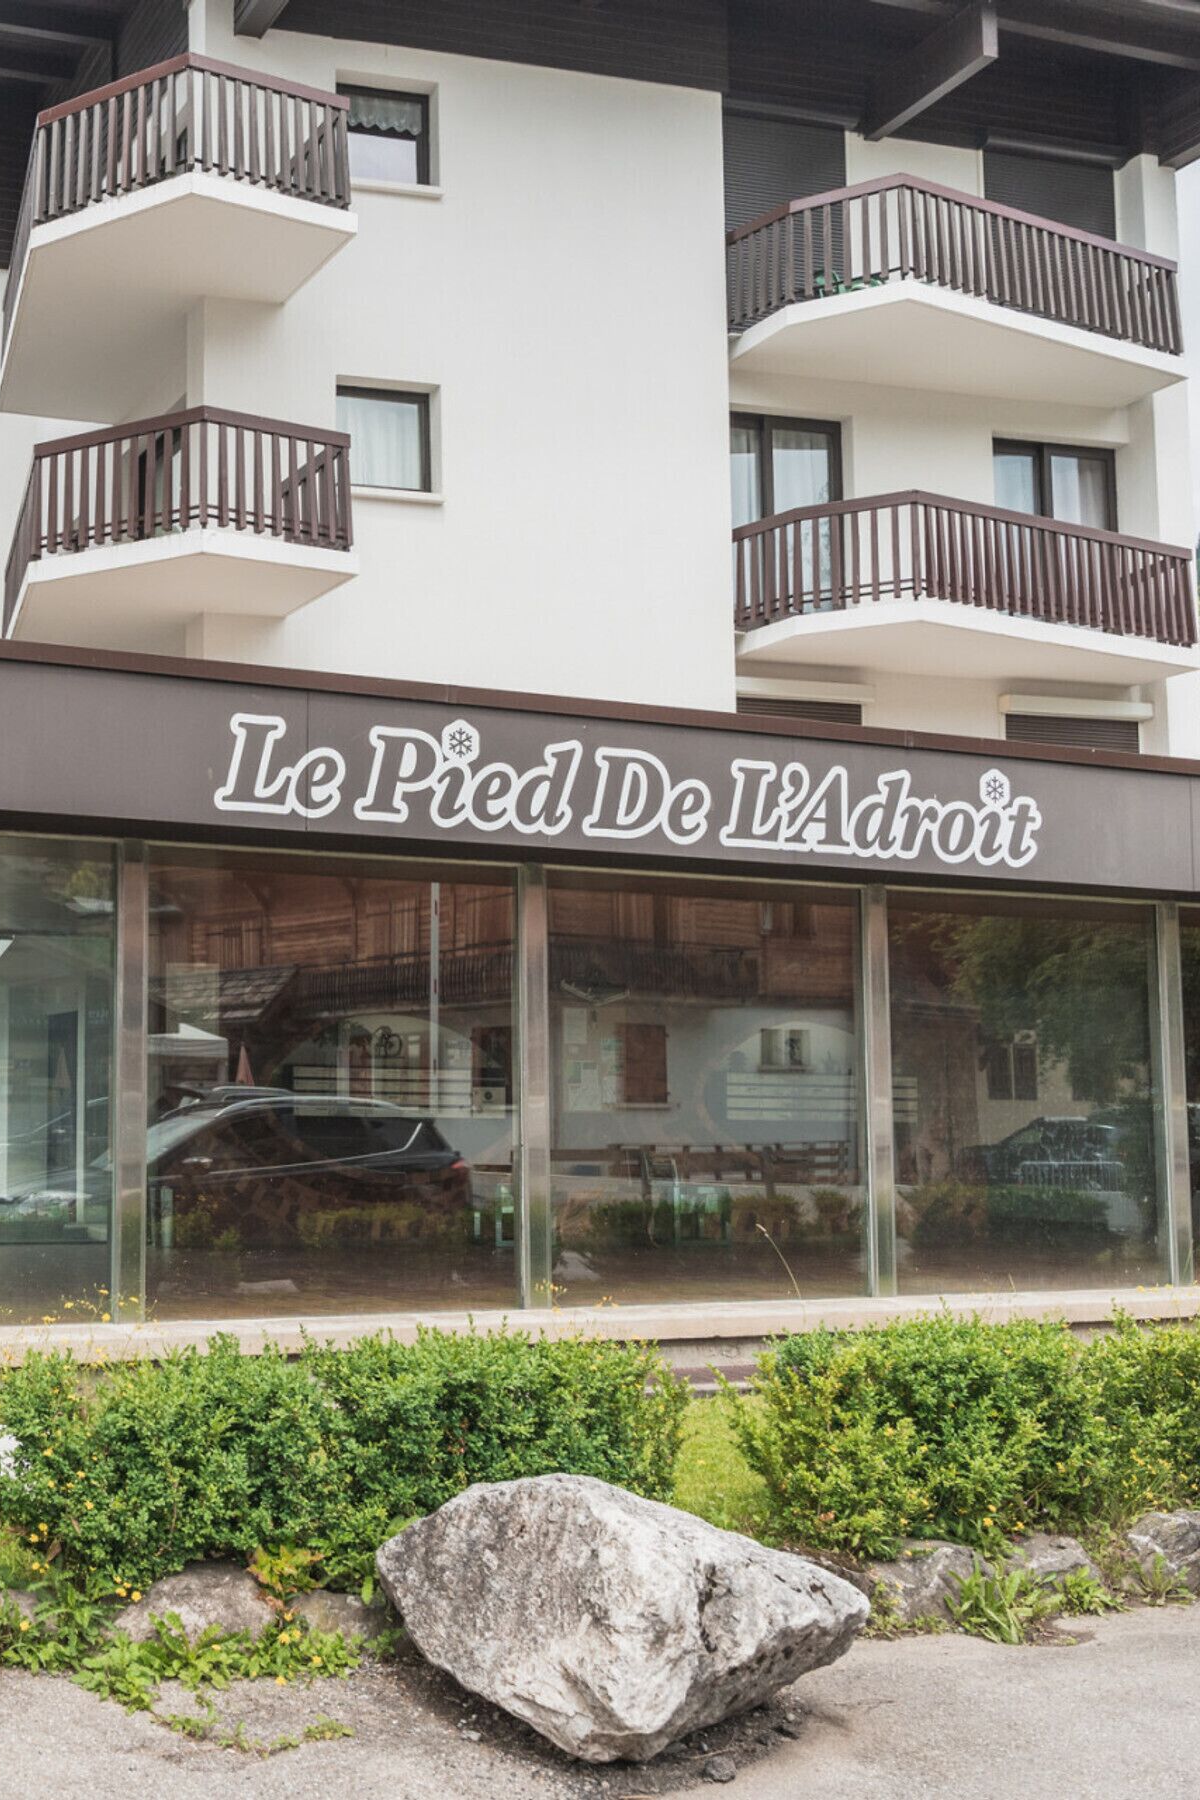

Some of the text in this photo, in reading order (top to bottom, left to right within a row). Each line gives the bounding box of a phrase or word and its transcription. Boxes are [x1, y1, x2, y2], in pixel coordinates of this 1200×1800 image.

[214, 713, 1042, 867] Le Pied De L'Adroit
